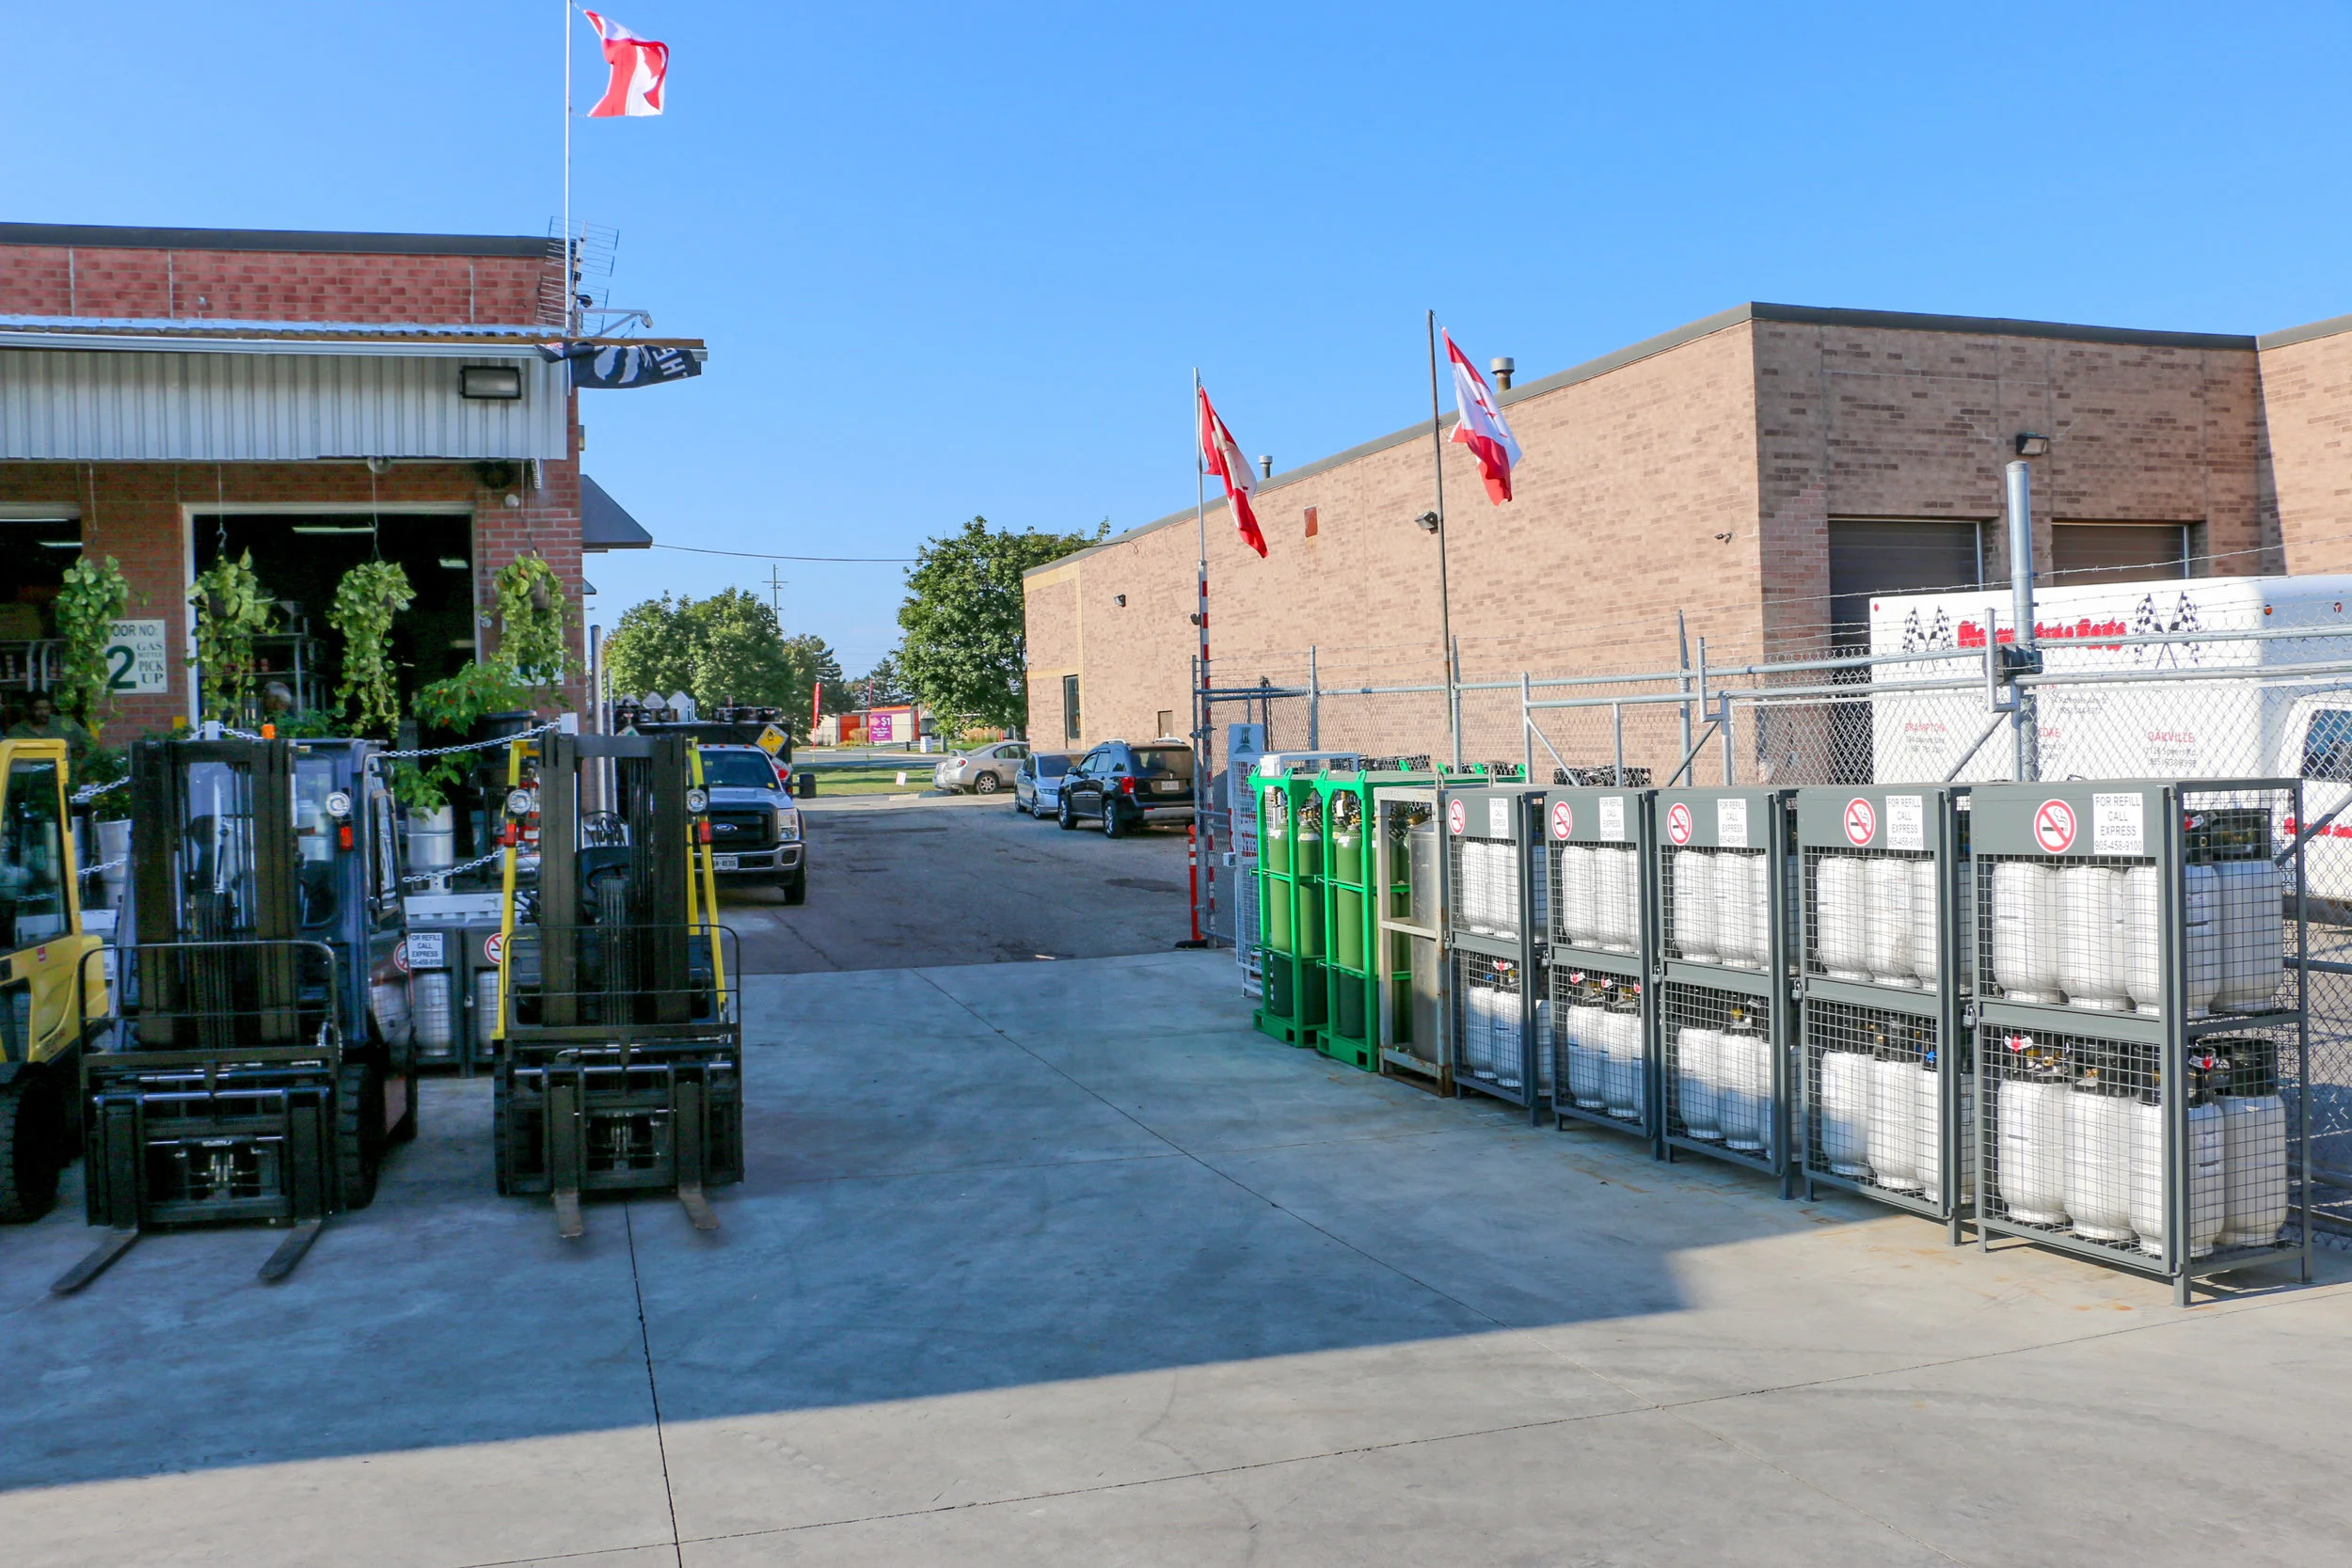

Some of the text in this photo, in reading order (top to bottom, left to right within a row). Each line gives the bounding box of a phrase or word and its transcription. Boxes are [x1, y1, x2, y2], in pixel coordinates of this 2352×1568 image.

[111, 624, 136, 637] OOR
[136, 641, 163, 651] GAS
[105, 645, 137, 689] 2
[138, 660, 164, 672] PICK
[141, 673, 164, 684] UP
[881, 717, 891, 726] $1
[2147, 731, 2196, 743] OAKVILLE
[1887, 798, 1920, 808] FOR REFILL
[2095, 796, 2141, 807] FOR REFILL
[1726, 813, 1738, 821] CALL
[1897, 811, 1912, 820] CALL
[2107, 811, 2128, 822] CALL
[1722, 824, 1743, 832] EXPRESS
[1892, 824, 1918, 833] EXPRESS
[2100, 825, 2137, 836] EXPRESS
[2095, 840, 2142, 851] 905-458-9100
